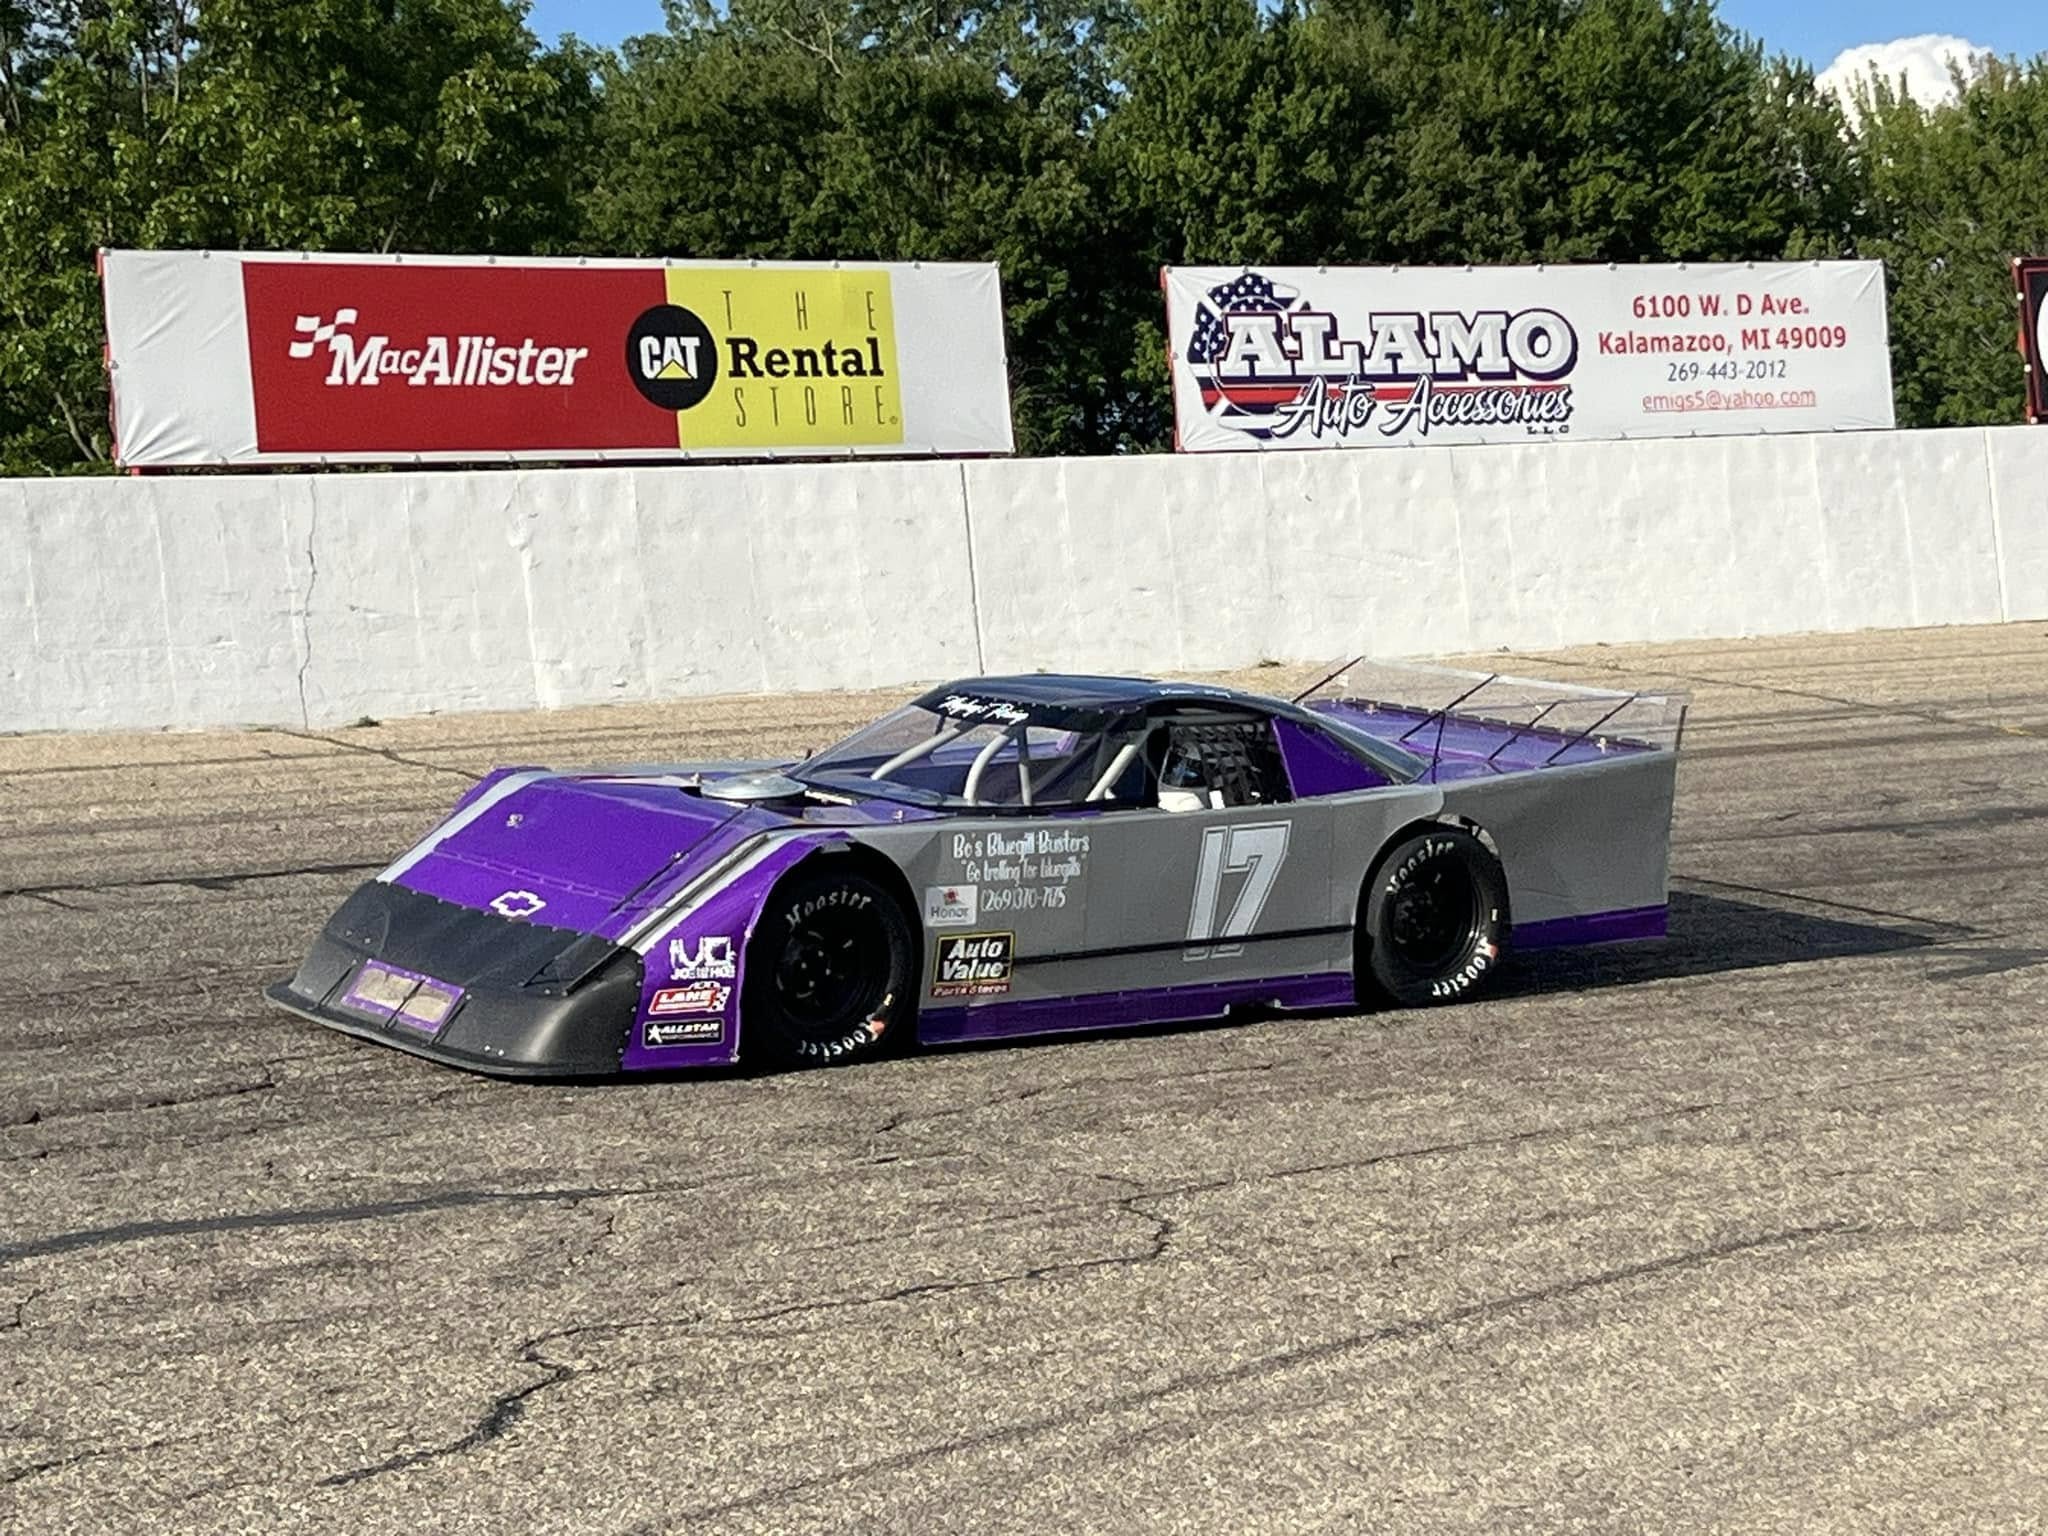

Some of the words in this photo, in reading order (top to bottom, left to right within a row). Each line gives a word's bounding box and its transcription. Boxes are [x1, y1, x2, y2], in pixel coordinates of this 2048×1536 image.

[722, 290, 876, 331] THE
[1632, 295, 1691, 318] 6100
[1698, 294, 1728, 316] W.
[1736, 294, 1752, 316] D
[1760, 293, 1809, 316] Ave.
[639, 336, 700, 380] CAT
[725, 337, 884, 378] Rental
[1217, 308, 1578, 382] ALAMO
[1598, 330, 1733, 356] Kalamazoo,
[1741, 328, 1771, 351] MI
[1776, 326, 1847, 349] 49009
[325, 336, 589, 386] MacAllister
[1667, 360, 1787, 382] 269-443-2012
[735, 385, 886, 427] STORE
[1272, 374, 1377, 438] Auto
[1379, 374, 1573, 437] Accessories
[1642, 388, 1817, 413] emigs5@yahoo.com
[953, 832, 983, 859] Bo's
[987, 831, 1035, 862] Bluegill
[1183, 820, 1292, 962] 17
[931, 906, 969, 918] Honor
[948, 938, 1004, 959] Auto
[943, 959, 1004, 981] Value
